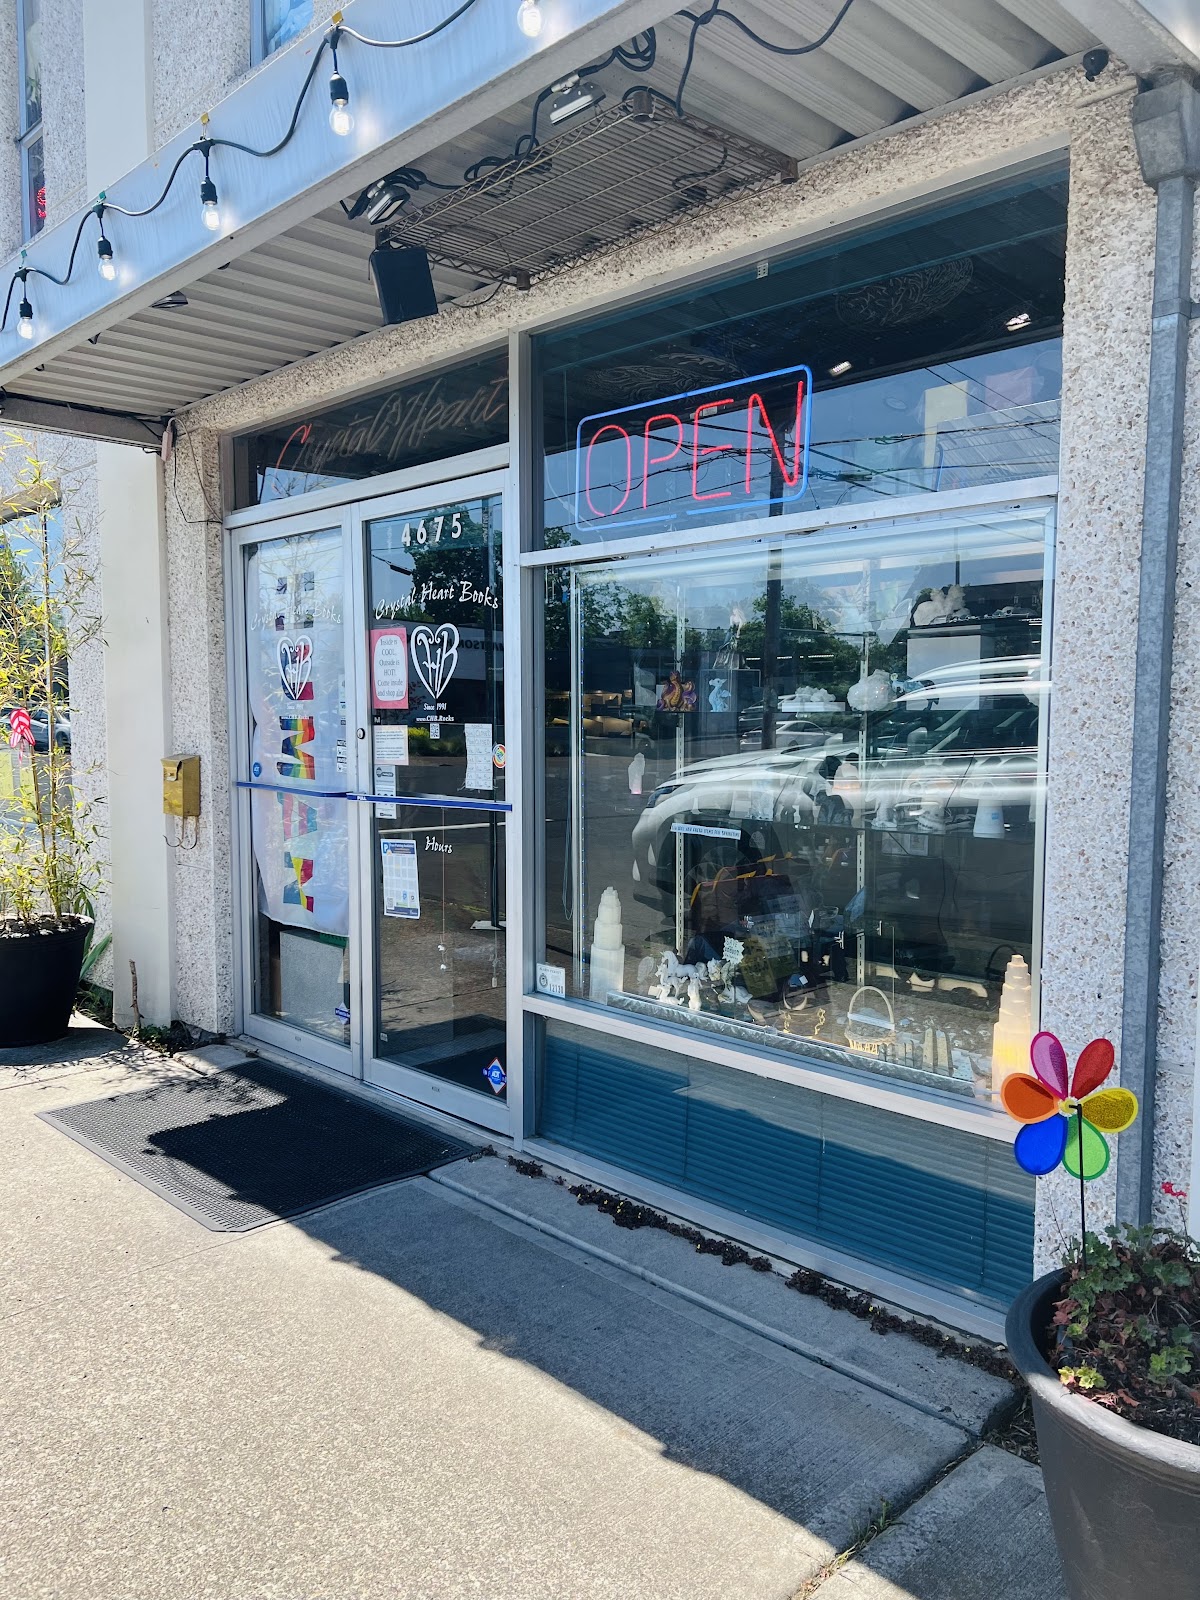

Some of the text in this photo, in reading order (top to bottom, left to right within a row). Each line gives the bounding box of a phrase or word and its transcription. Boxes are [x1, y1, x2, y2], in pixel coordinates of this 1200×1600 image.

[585, 380, 804, 517] OPEN
[401, 512, 462, 547] 4675
[374, 580, 499, 621] Crystal Heart Books
[423, 702, 447, 711] Since 1991
[424, 835, 453, 854] Hours
